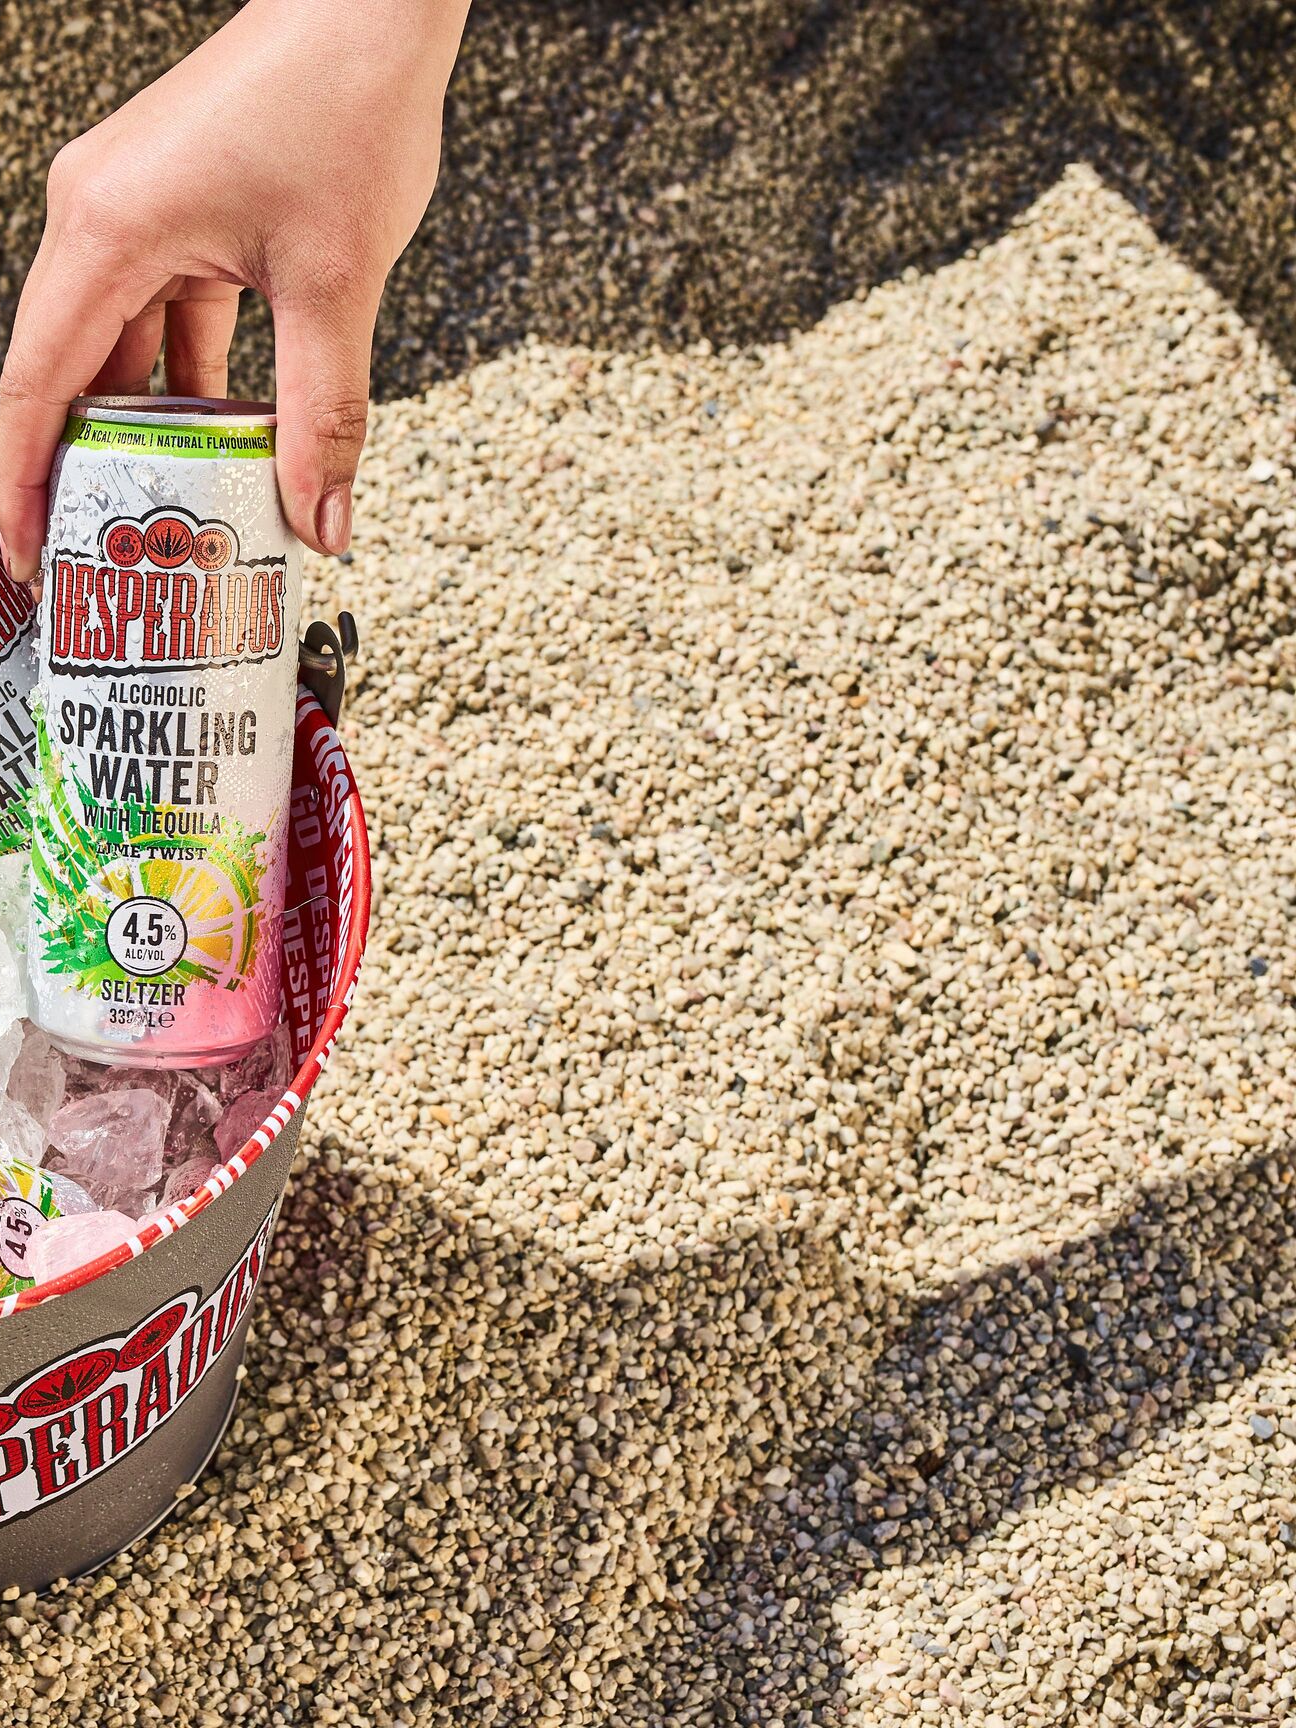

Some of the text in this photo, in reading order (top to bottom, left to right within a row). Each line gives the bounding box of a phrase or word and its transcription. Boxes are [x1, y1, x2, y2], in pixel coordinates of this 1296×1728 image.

[78, 422, 269, 450] 28 KCAL/100ML NATURAL FLAVOURINGS
[54, 560, 284, 662] DESPERADOS
[108, 682, 206, 707] ALCOHOLIC
[60, 700, 257, 757] SPARKLING
[89, 753, 219, 805] WATER
[83, 804, 222, 838] WITH TEQUILA
[97, 841, 207, 861] LIME TWIST
[122, 911, 177, 946] 4.5%
[124, 946, 166, 961] ALC/VOL
[101, 978, 185, 1006] SELTZER
